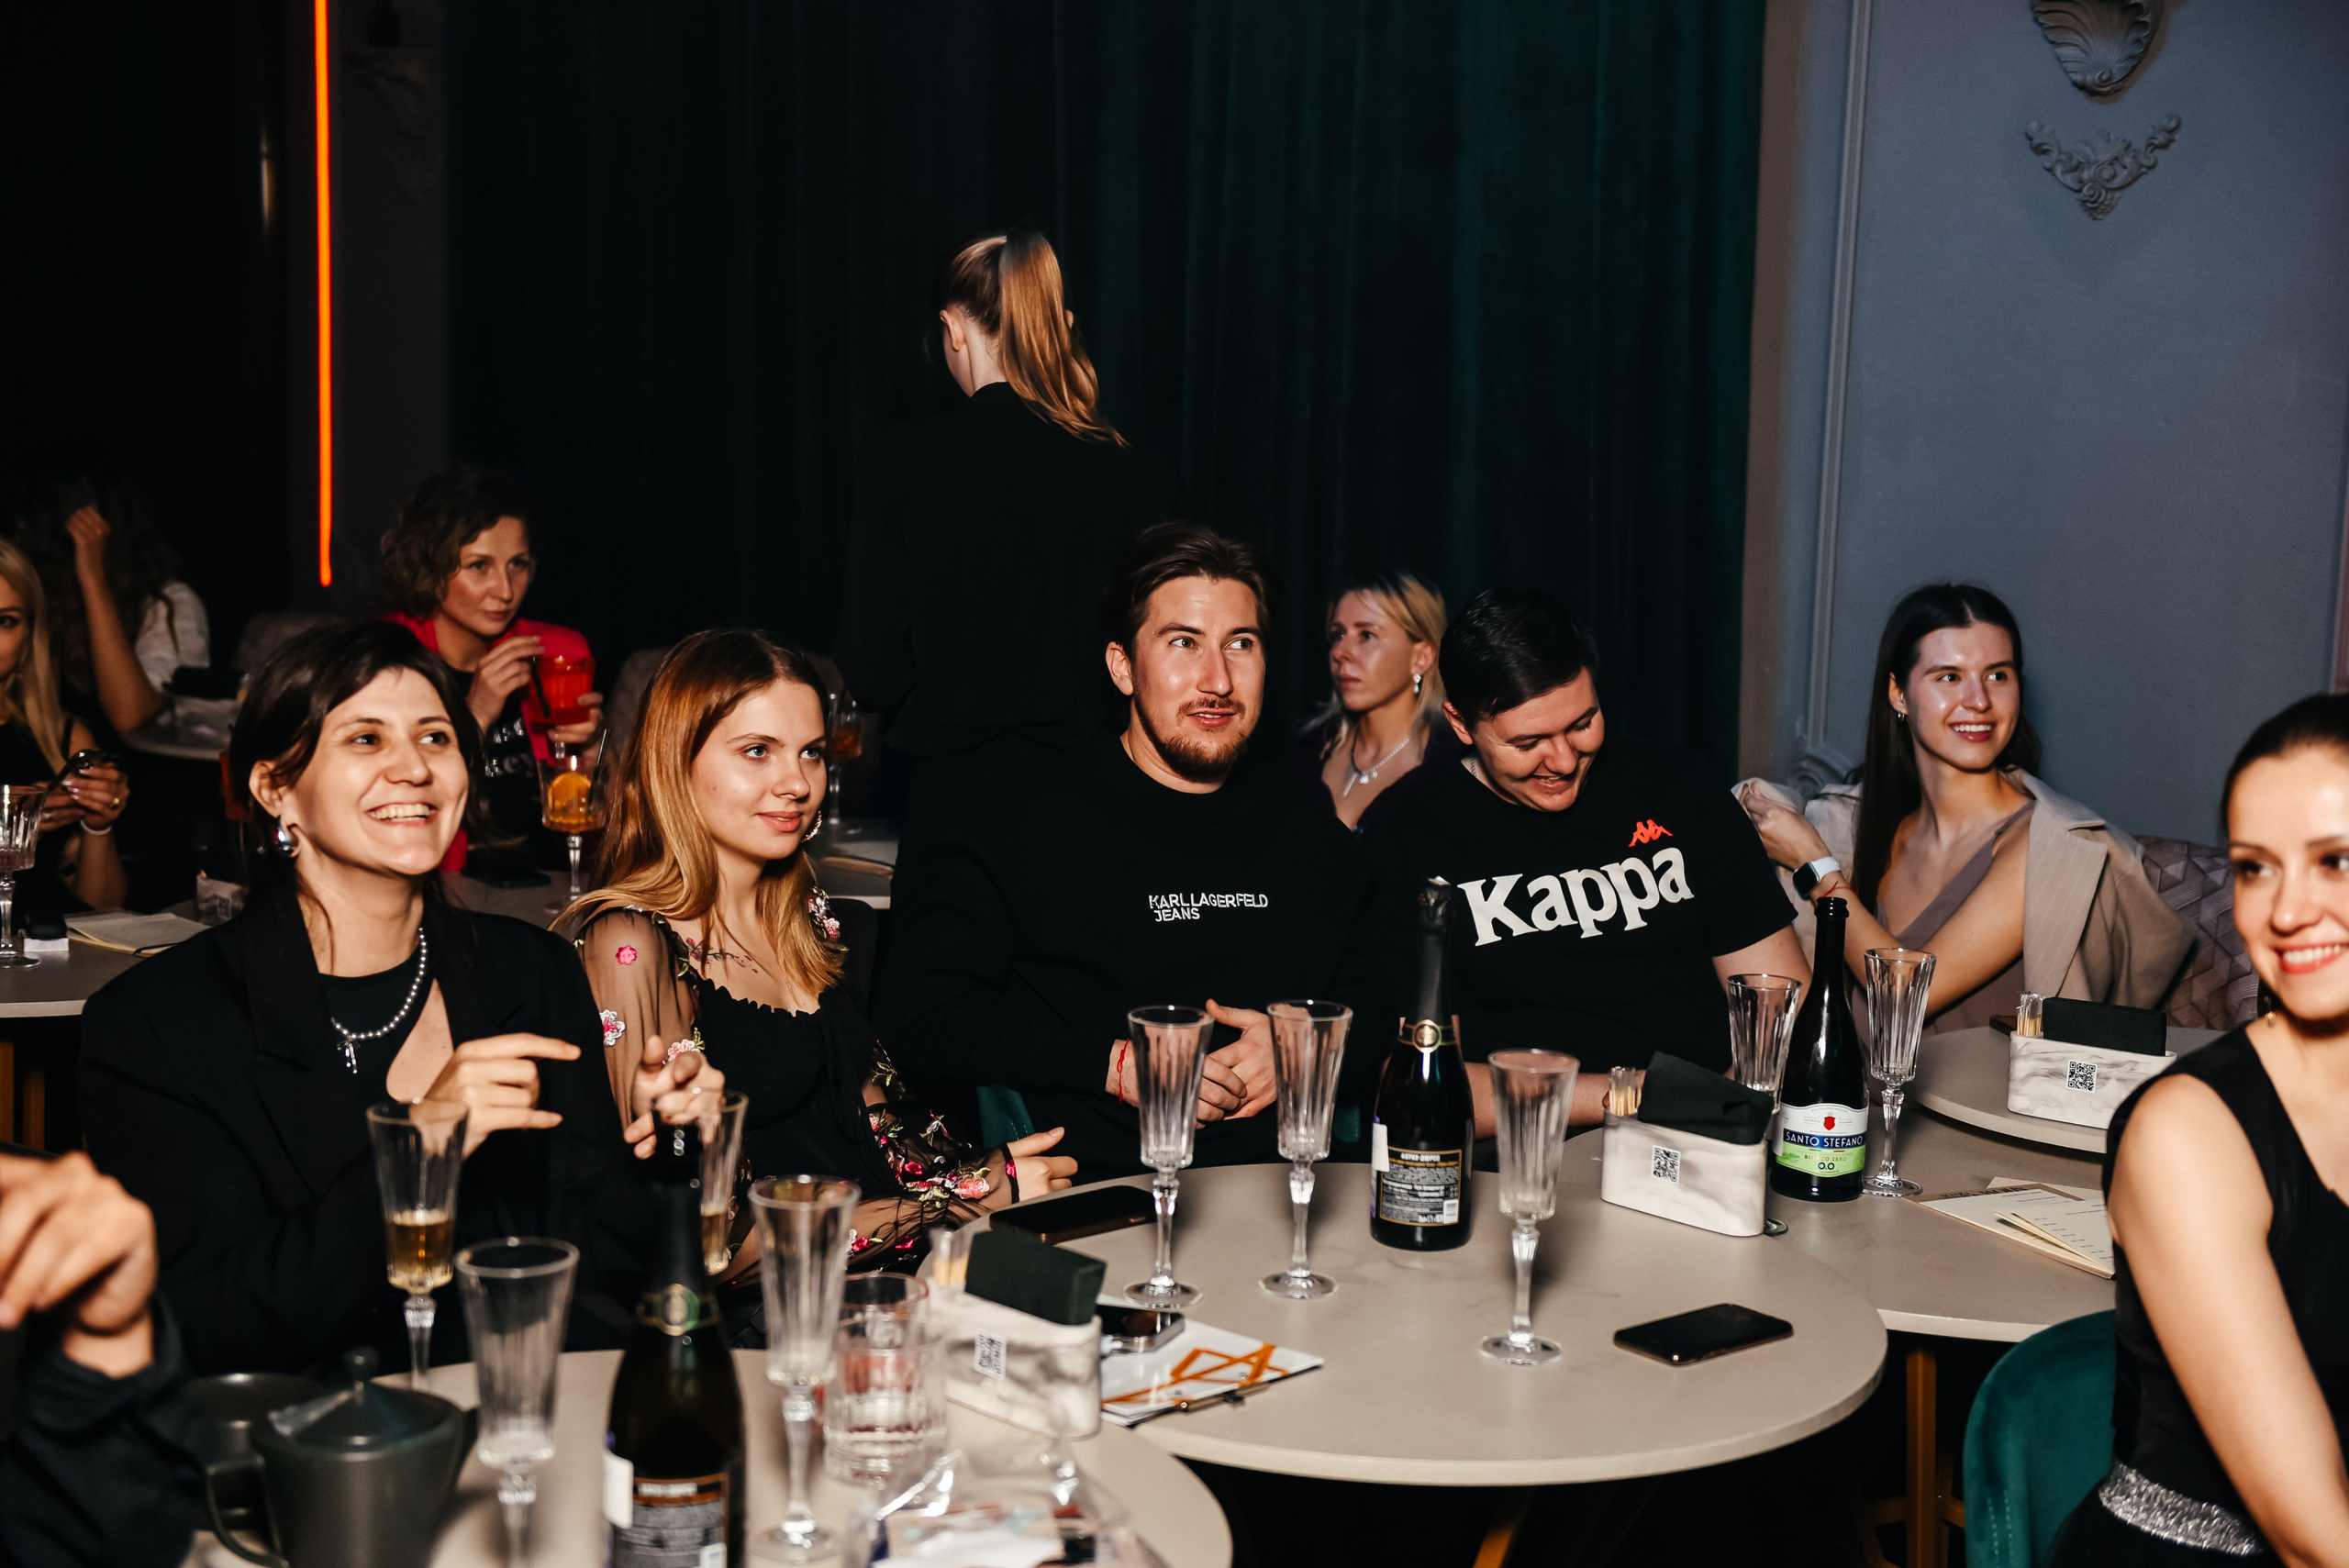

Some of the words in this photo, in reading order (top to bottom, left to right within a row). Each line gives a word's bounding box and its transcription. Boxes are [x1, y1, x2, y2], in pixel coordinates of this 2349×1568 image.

[1148, 893, 1190, 909] KARL
[1190, 892, 1269, 908] LAGERFELD
[1456, 847, 1695, 947] Kappa
[1153, 906, 1200, 922] JEANS
[1786, 1131, 1820, 1147] SANTO
[1823, 1135, 1863, 1148] STEFANO
